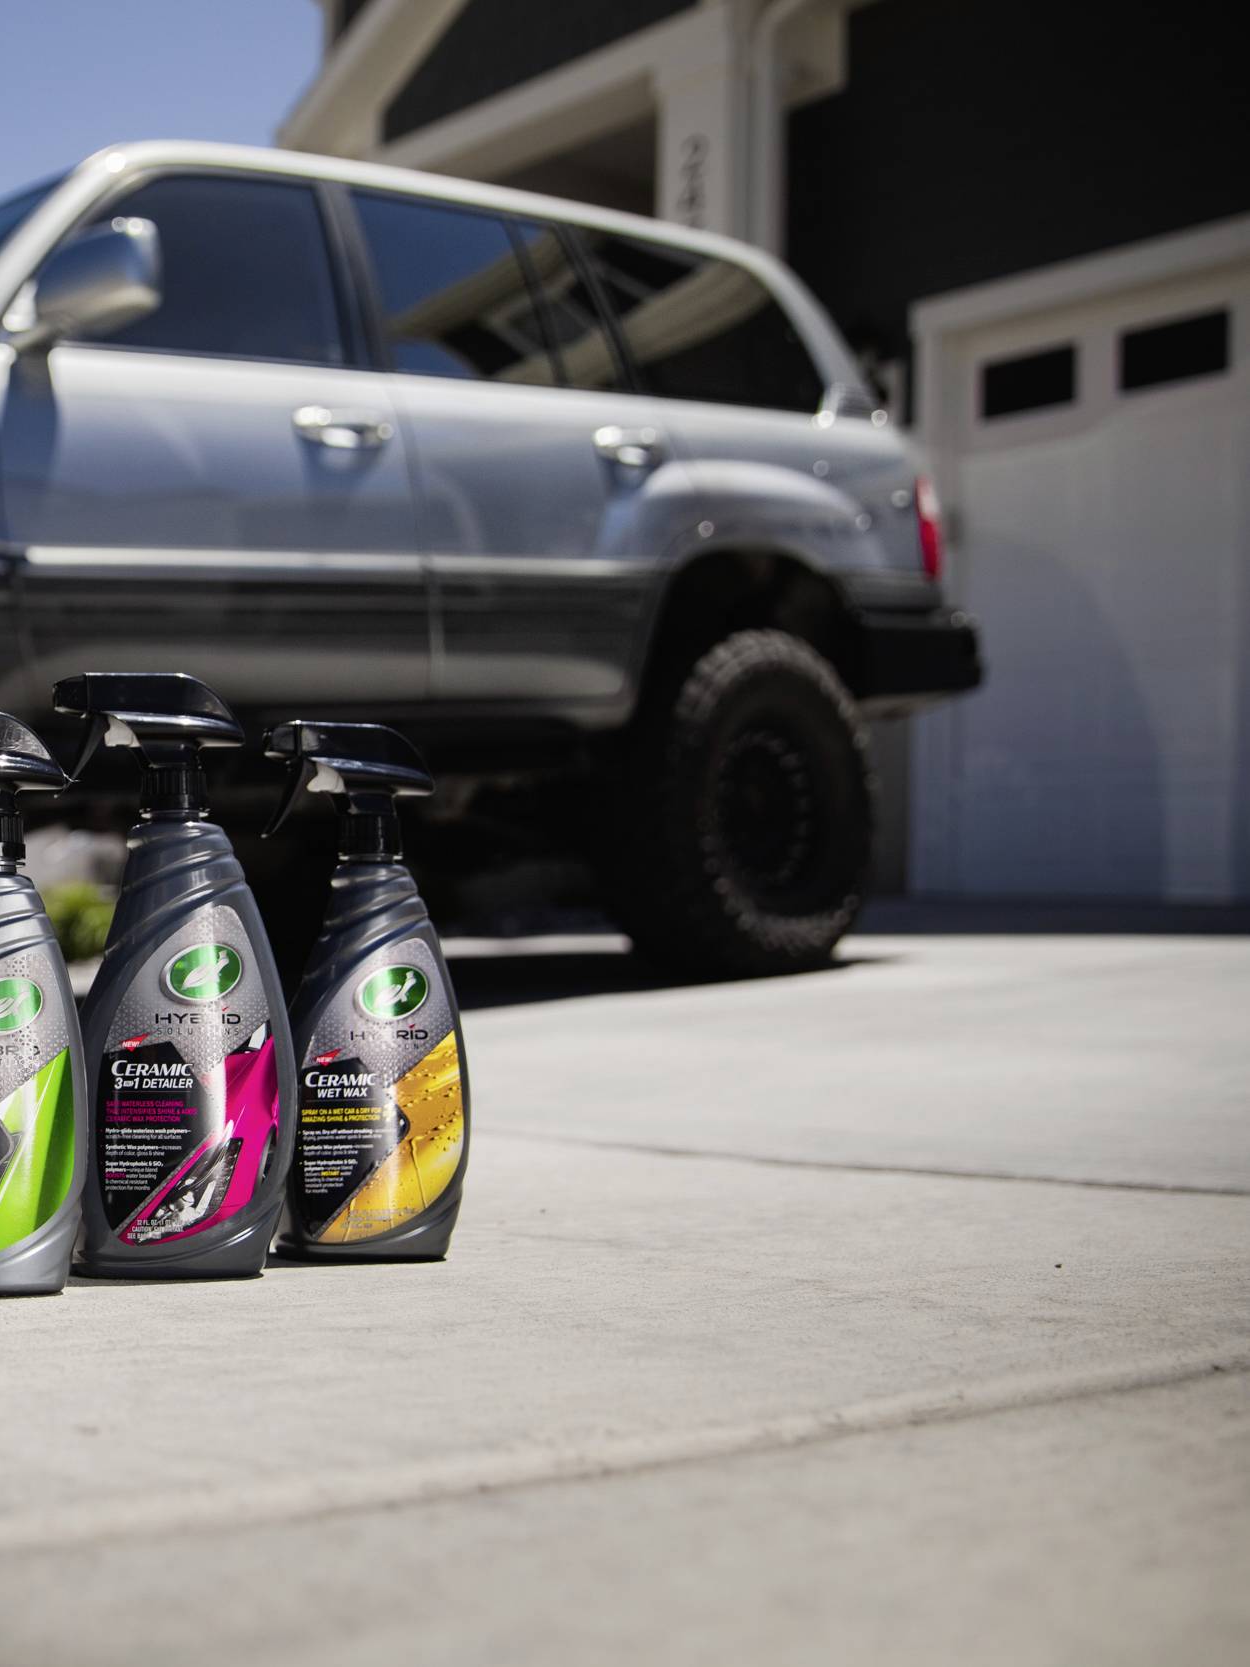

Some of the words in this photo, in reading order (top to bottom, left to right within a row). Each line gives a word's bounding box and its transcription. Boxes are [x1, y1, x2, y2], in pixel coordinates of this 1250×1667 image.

[111, 1060, 194, 1077] CERAMIC
[142, 1078, 194, 1089] DETAILER
[305, 1071, 377, 1088] CERAMIC
[317, 1088, 341, 1098] WET
[343, 1087, 368, 1097] WAX
